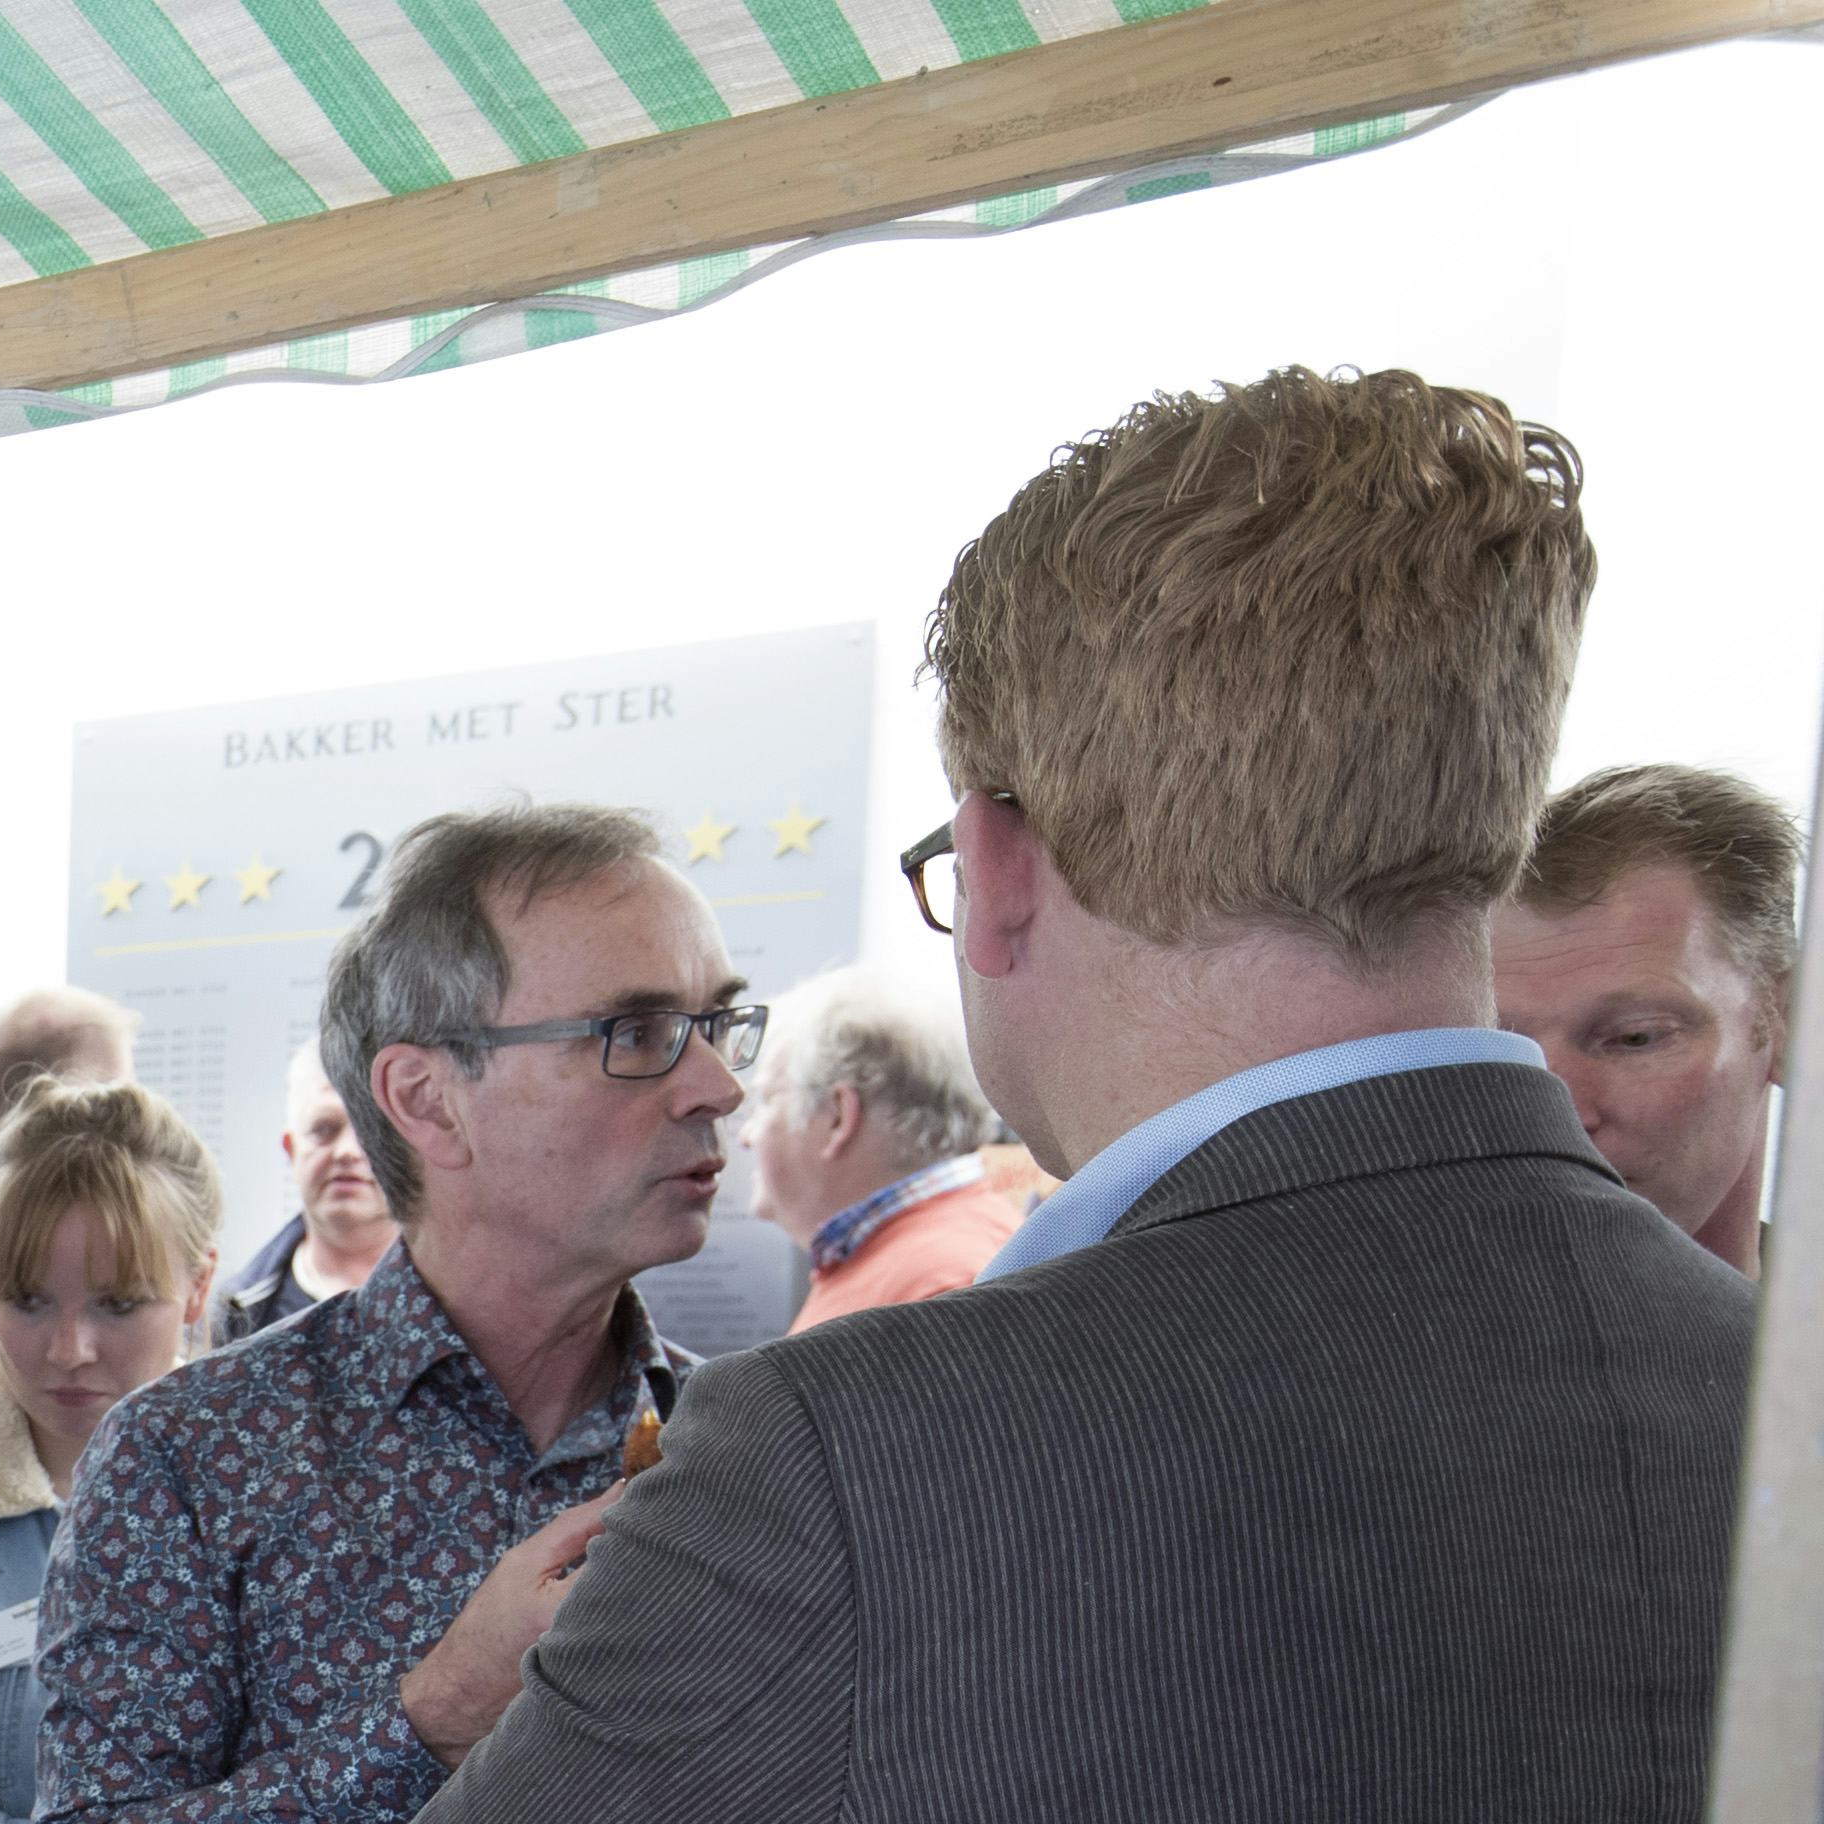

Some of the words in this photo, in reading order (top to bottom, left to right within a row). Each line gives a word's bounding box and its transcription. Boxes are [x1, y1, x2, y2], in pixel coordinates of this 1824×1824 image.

[224, 718, 396, 770] BAKKER
[426, 702, 522, 742] MET
[554, 683, 677, 733] STER
